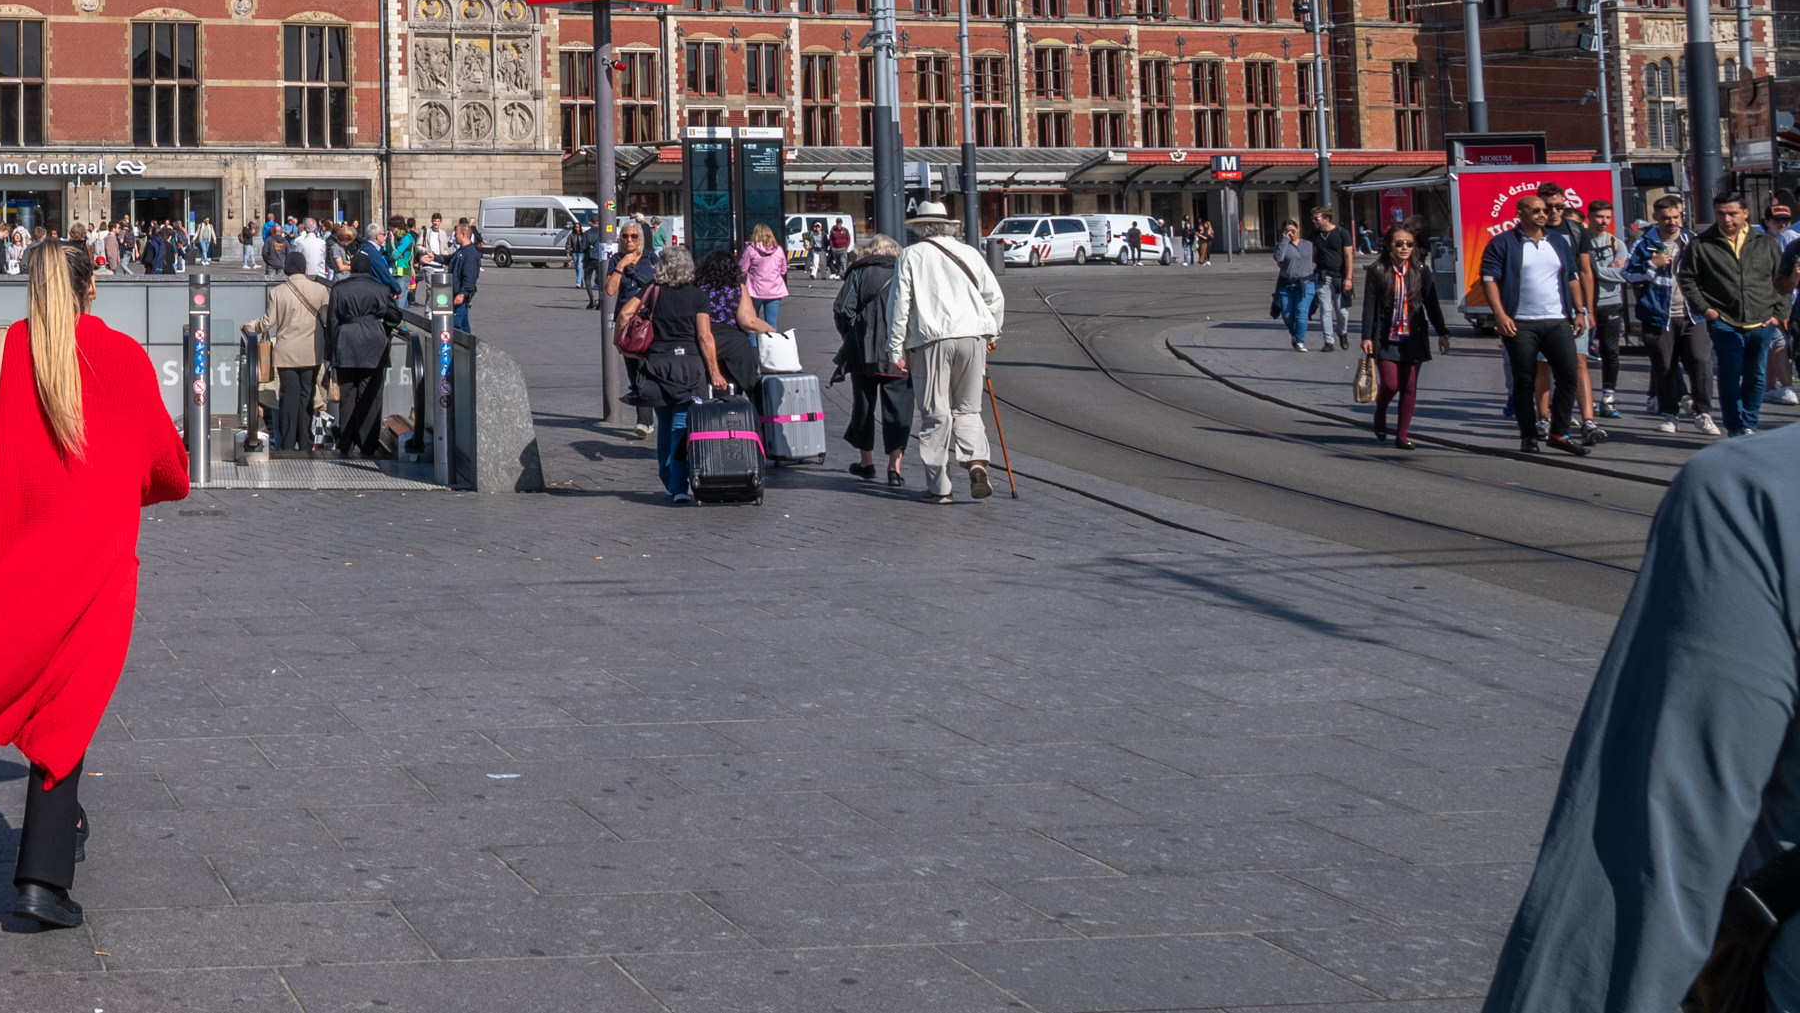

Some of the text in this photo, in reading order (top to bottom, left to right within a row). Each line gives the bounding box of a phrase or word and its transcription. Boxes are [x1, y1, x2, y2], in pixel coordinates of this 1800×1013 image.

[26, 158, 104, 175] Centraal
[1221, 155, 1237, 171] M
[906, 197, 920, 216] A
[1490, 193, 1509, 219] cold
